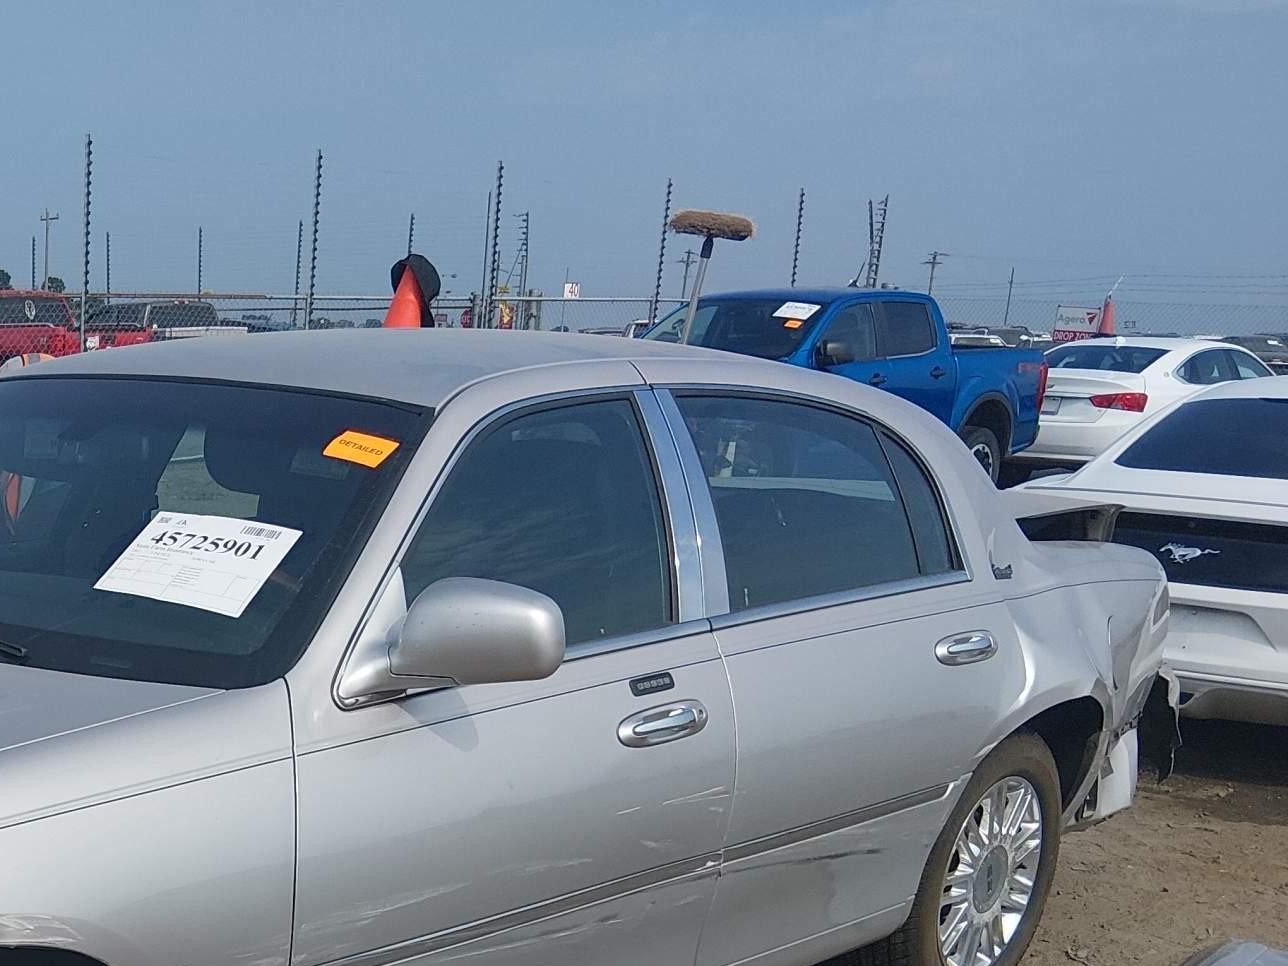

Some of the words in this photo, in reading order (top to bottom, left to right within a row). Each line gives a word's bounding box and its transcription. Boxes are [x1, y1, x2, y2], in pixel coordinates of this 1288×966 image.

[1054, 331, 1074, 341] DROP
[339, 439, 384, 456] DETAILED
[151, 530, 265, 560] 45725901
